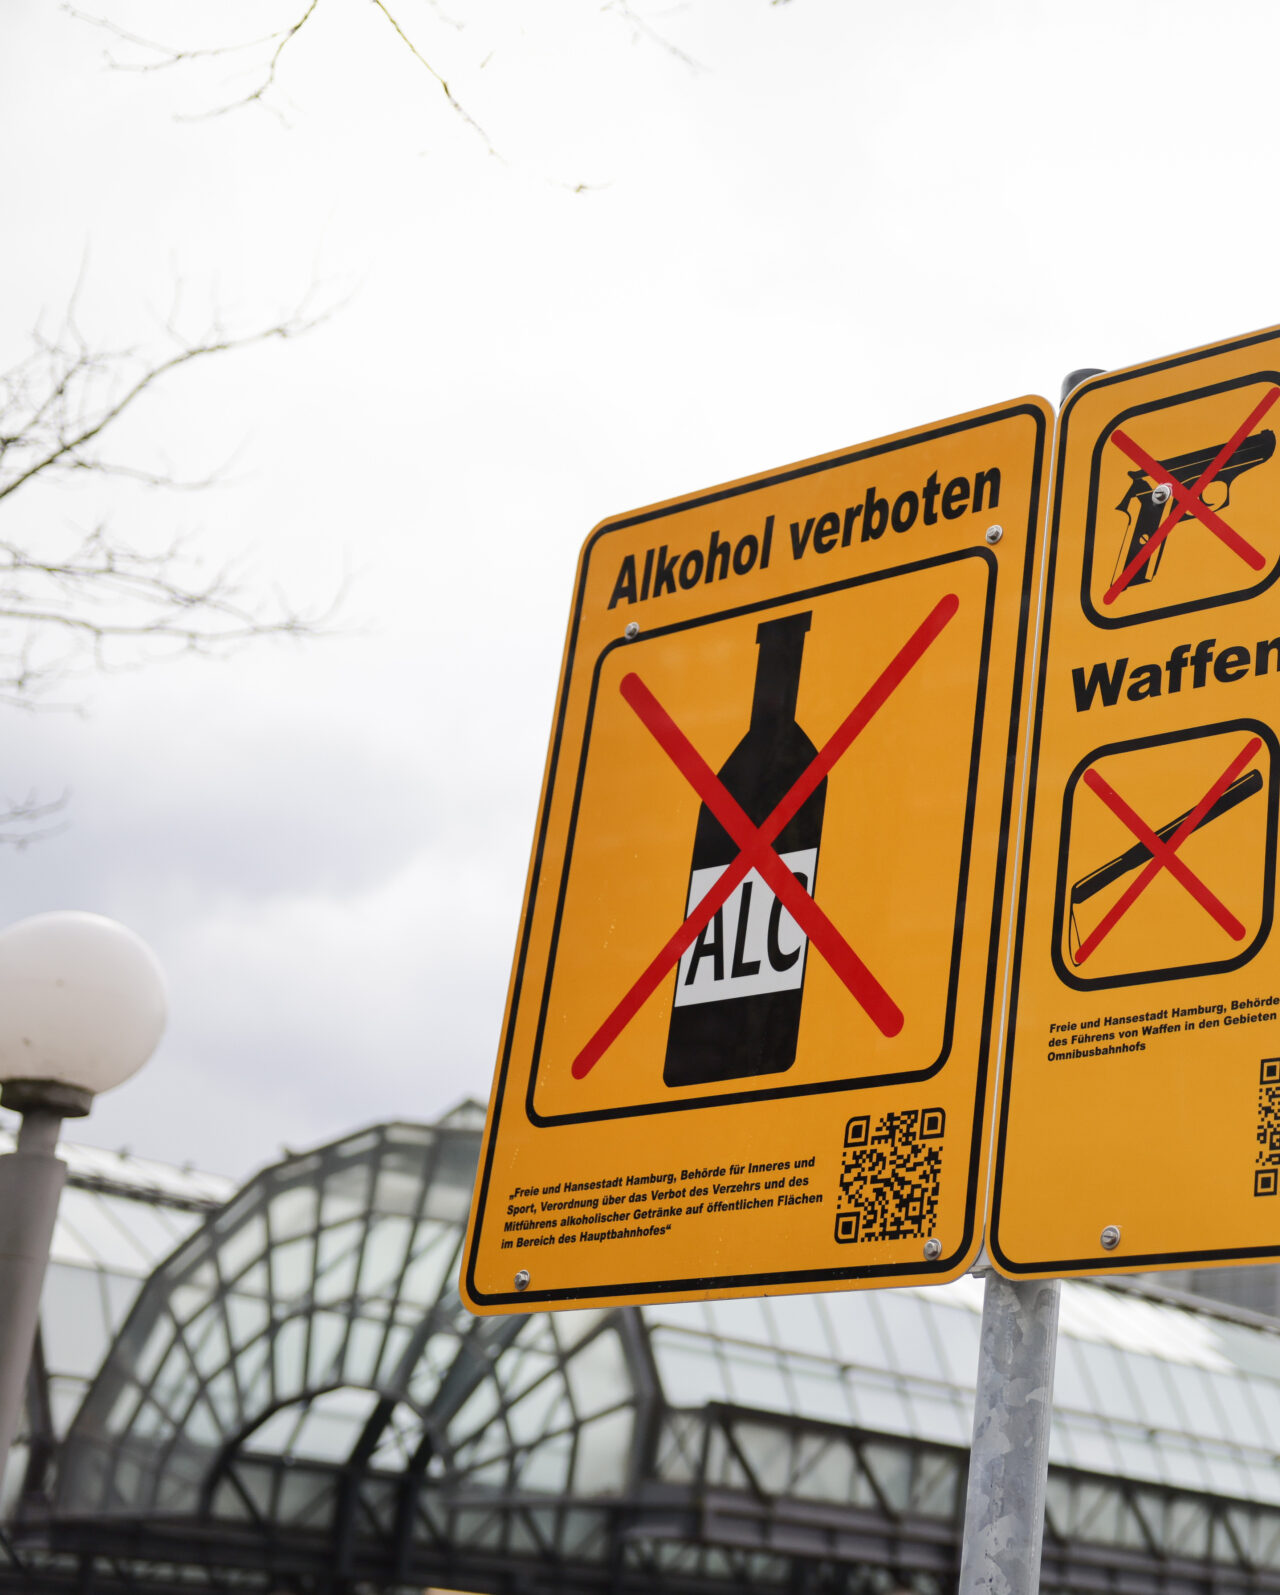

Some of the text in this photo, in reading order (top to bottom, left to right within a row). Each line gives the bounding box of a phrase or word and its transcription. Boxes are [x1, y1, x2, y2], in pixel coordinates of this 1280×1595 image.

[607, 467, 1001, 611] Alkohol verboten
[684, 871, 808, 986] ALC
[1048, 1038, 1068, 1047] des
[1071, 1032, 1115, 1045] Führens
[1118, 1030, 1138, 1039] von
[1142, 1023, 1181, 1036] Waffen
[1184, 1021, 1195, 1031] in
[1198, 1019, 1220, 1029] den
[1223, 1012, 1277, 1026] Gebieten
[1050, 1022, 1077, 1033] Freie
[1080, 1018, 1101, 1030] und
[1104, 1010, 1168, 1026] Hansestadt
[1171, 1004, 1227, 1018] Hamburg,
[1231, 996, 1280, 1010] Behörde
[1047, 1041, 1146, 1062] Omnibusbahnhofs
[506, 1176, 809, 1217] Sport, Verordnung über das Verbot des Verzehrs und des
[509, 1156, 816, 1200] „Freie und Hansestadt Hamburg, Behörde für Inneres und
[504, 1193, 823, 1232] Mitführens alkoholischer Getränke auf öffentlichen Flächen
[501, 1224, 672, 1249] im Bereich des Hauptbahnhofes“
